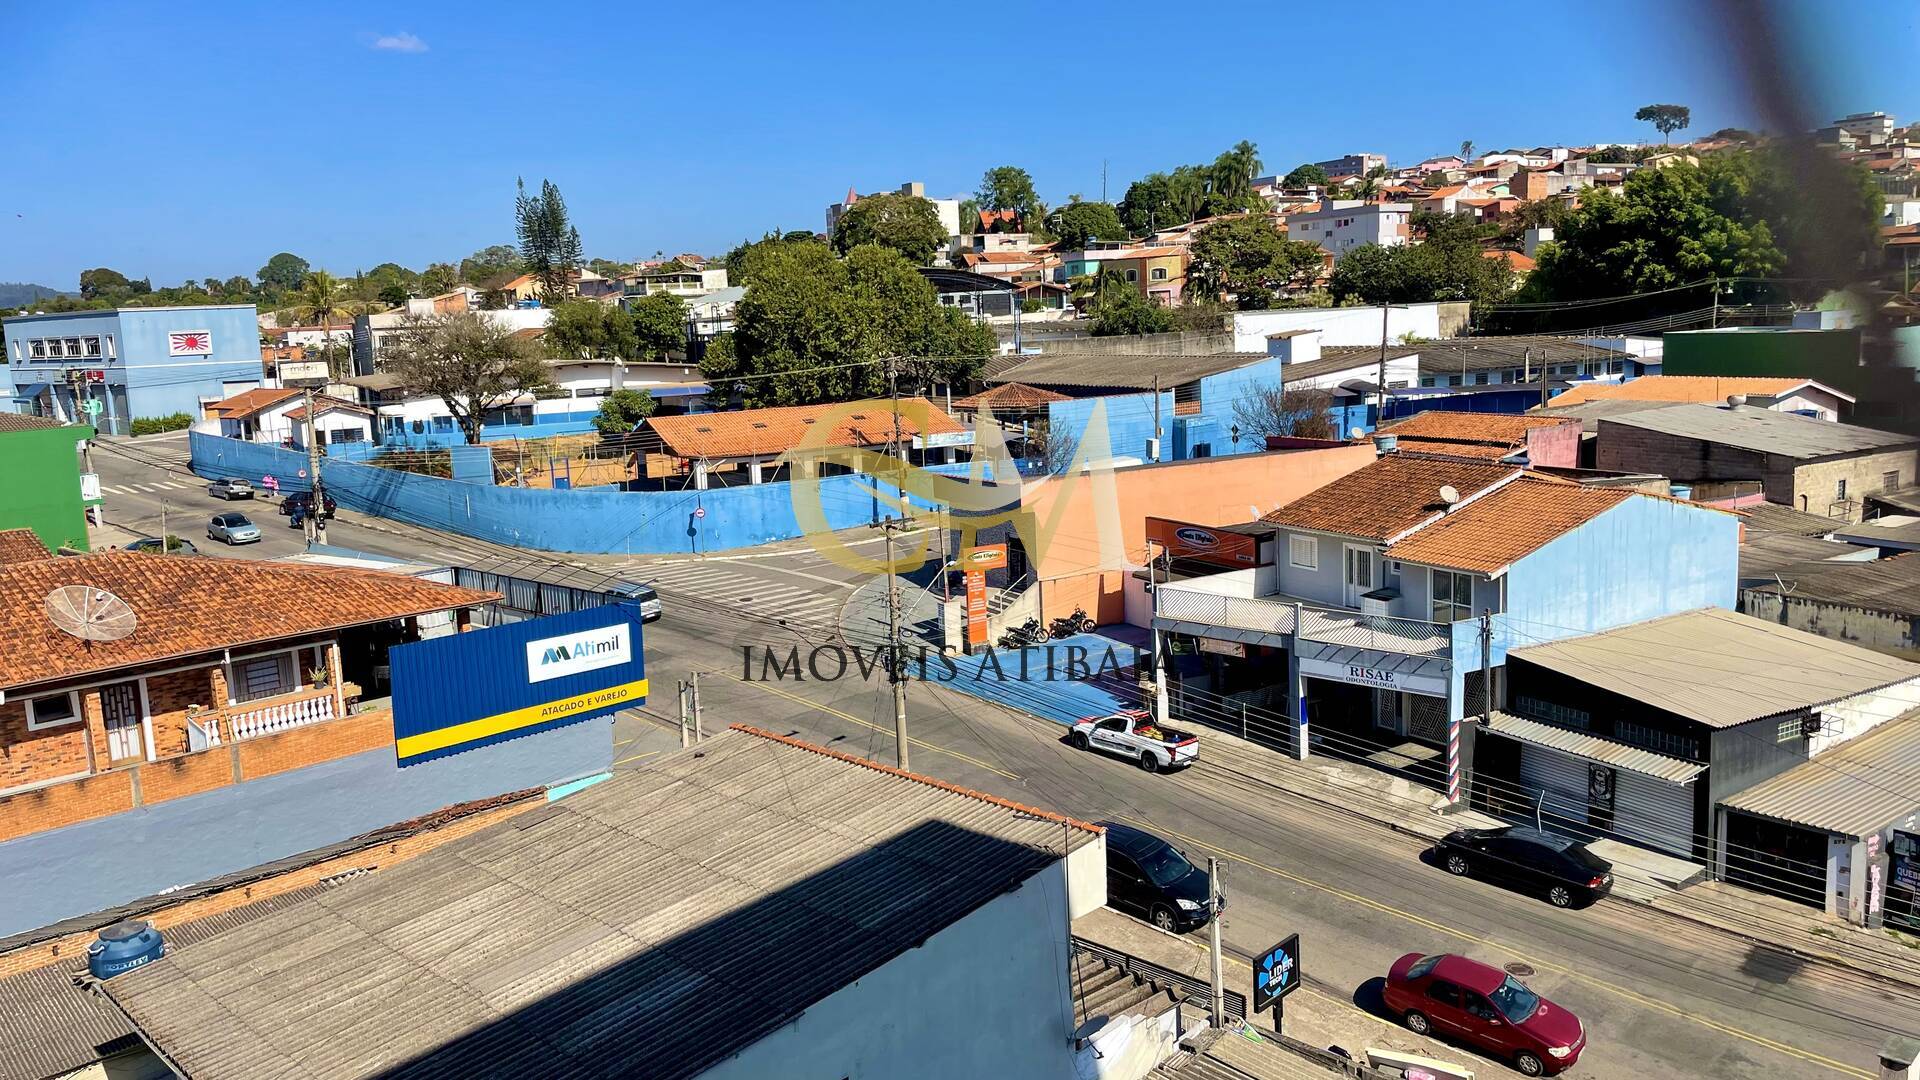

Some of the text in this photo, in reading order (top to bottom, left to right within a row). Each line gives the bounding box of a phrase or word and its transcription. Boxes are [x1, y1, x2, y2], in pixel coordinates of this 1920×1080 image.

[573, 635, 618, 659] Atimil
[1345, 676, 1398, 689] ODONTOLOGIA
[1350, 667, 1394, 682] RISAE
[541, 689, 627, 716] ATACADO E VAREJO
[1269, 957, 1293, 980] LIDER
[1269, 974, 1283, 987] TECH
